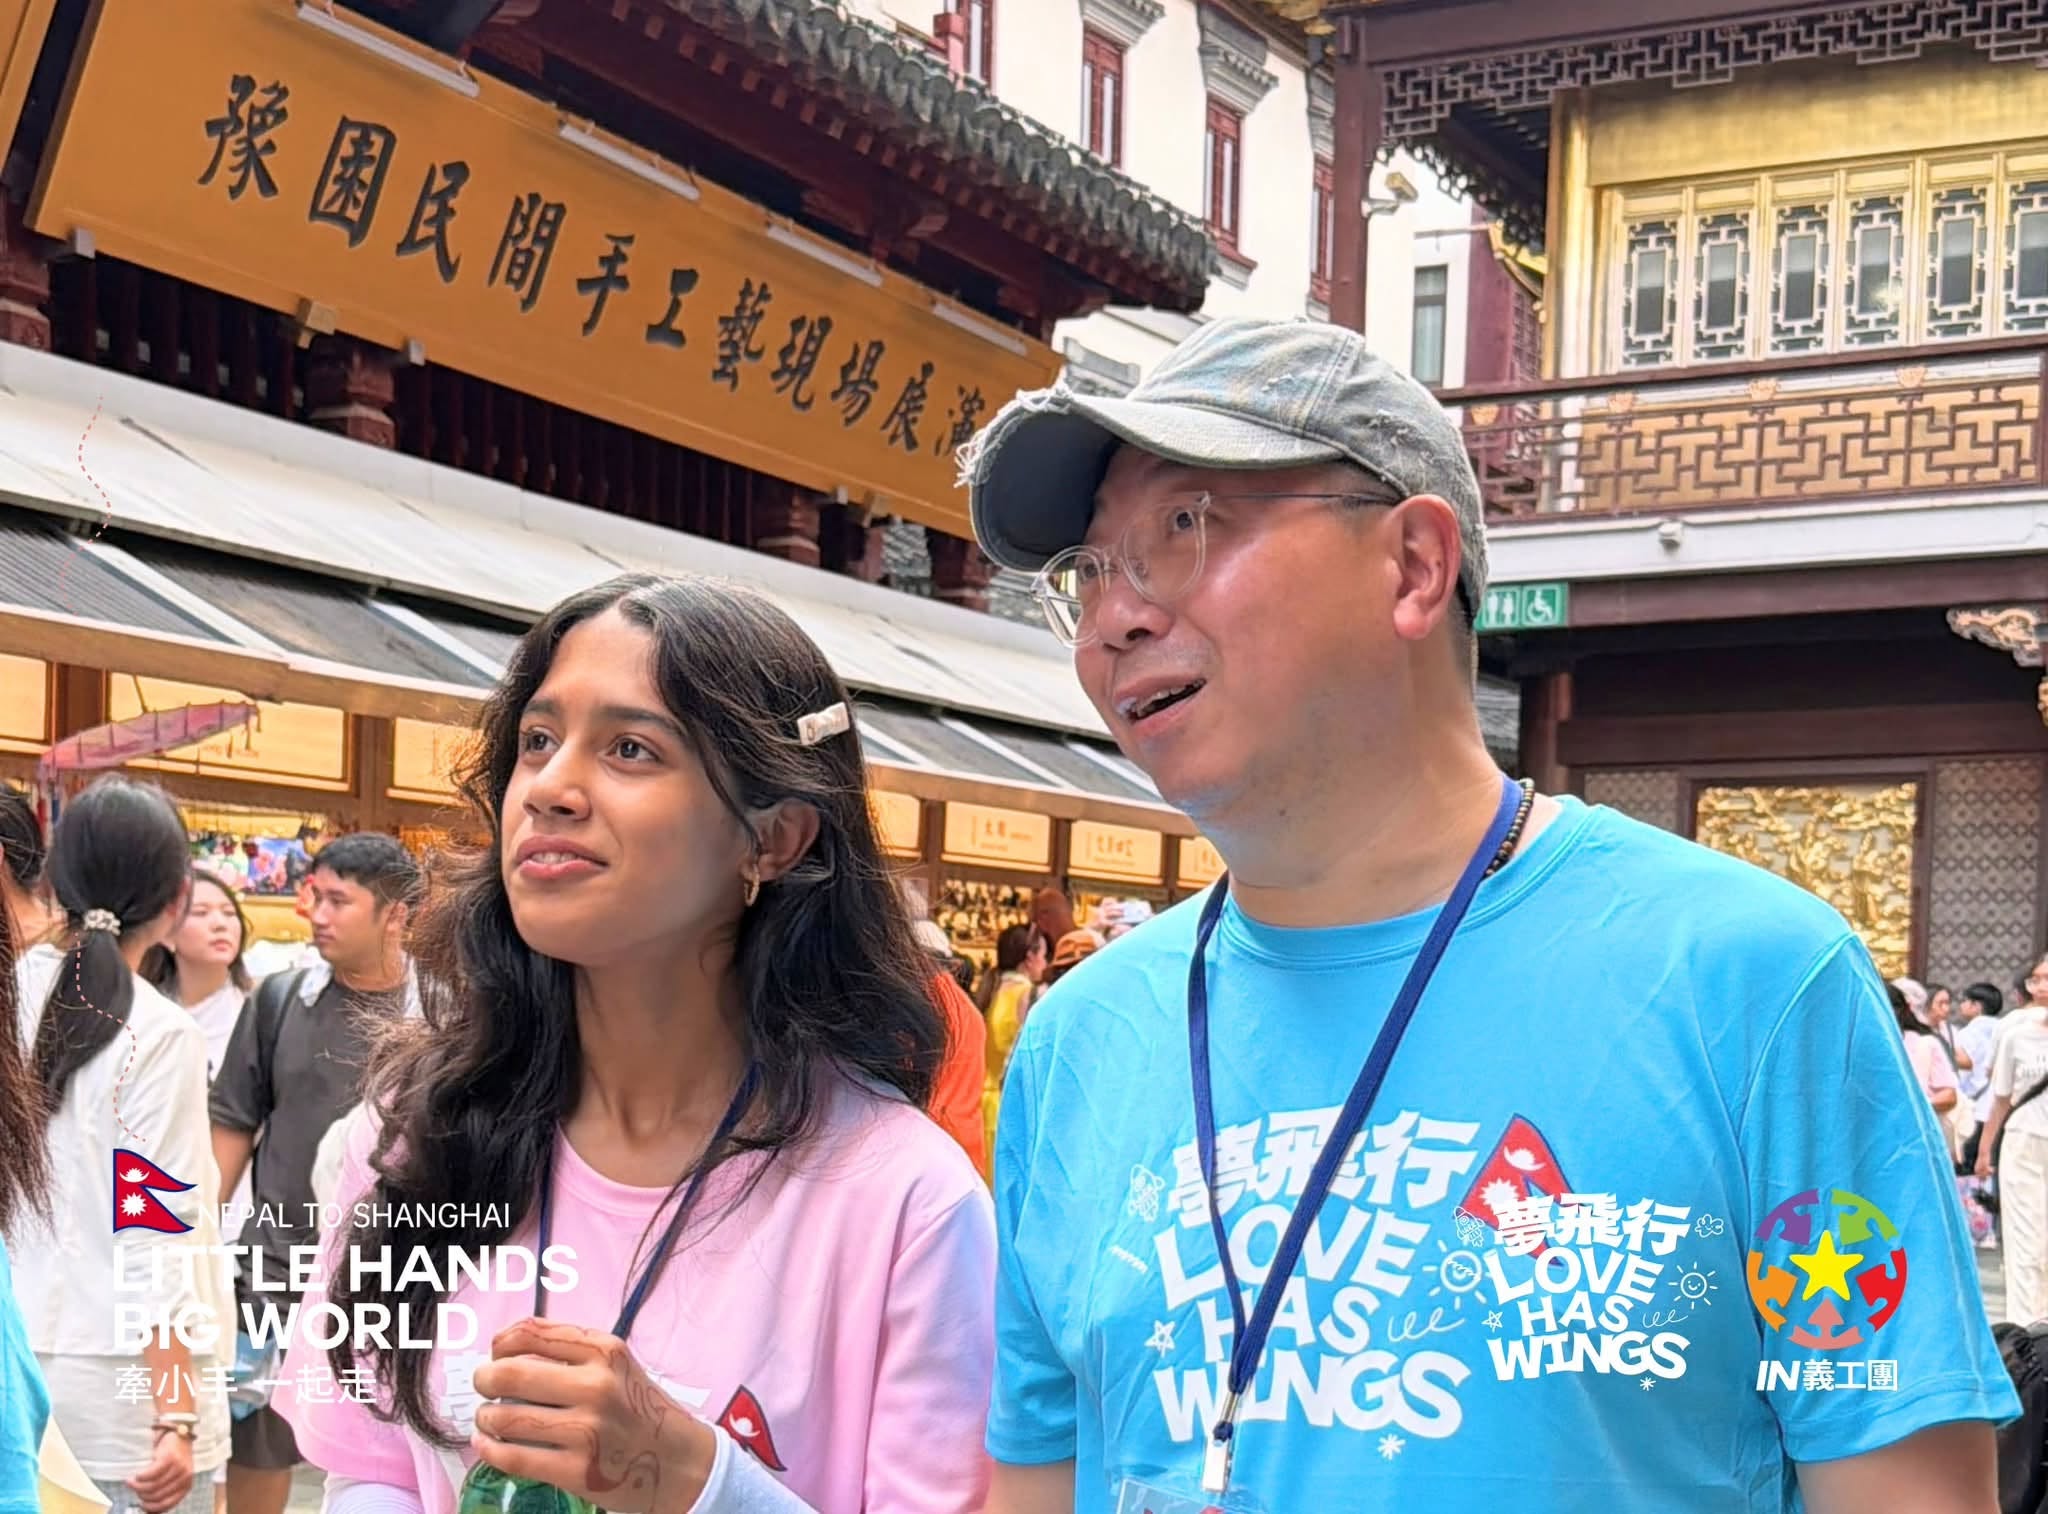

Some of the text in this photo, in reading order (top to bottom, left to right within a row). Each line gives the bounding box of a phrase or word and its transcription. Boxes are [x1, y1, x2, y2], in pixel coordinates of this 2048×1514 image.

[1167, 1103, 1481, 1228] 夢飛行
[1153, 1203, 1431, 1311] LOVE
[1196, 1275, 1381, 1368] HAS
